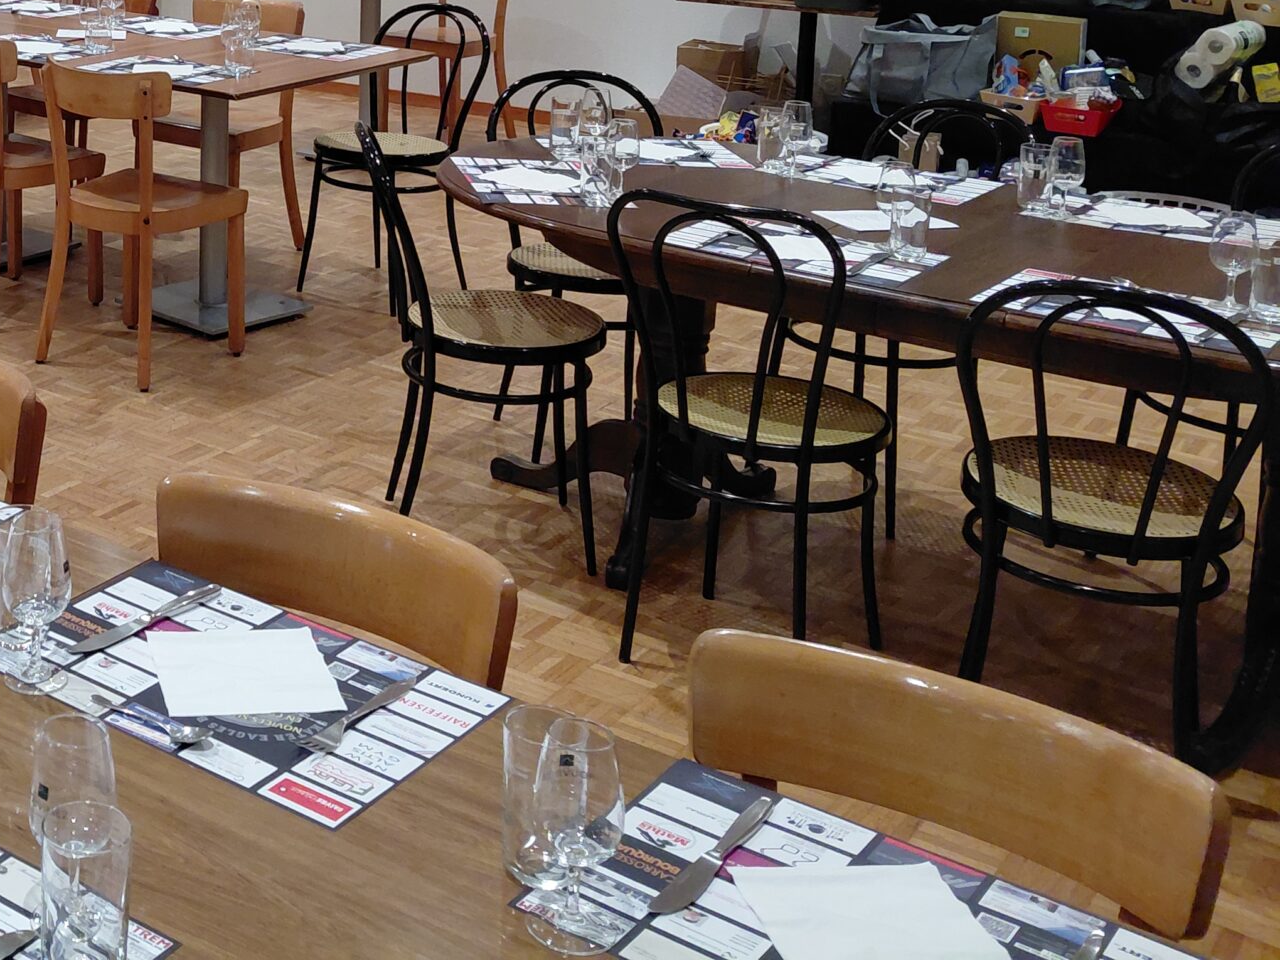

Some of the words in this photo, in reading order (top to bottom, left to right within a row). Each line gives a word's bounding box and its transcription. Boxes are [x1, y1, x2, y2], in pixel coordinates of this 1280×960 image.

[207, 722, 269, 742] EAGLES
[344, 751, 388, 773] NEW
[352, 745, 396, 767] ALTIS
[358, 742, 401, 764] GYM
[638, 820, 690, 847] Mathis
[614, 852, 676, 882] CARROSSE
